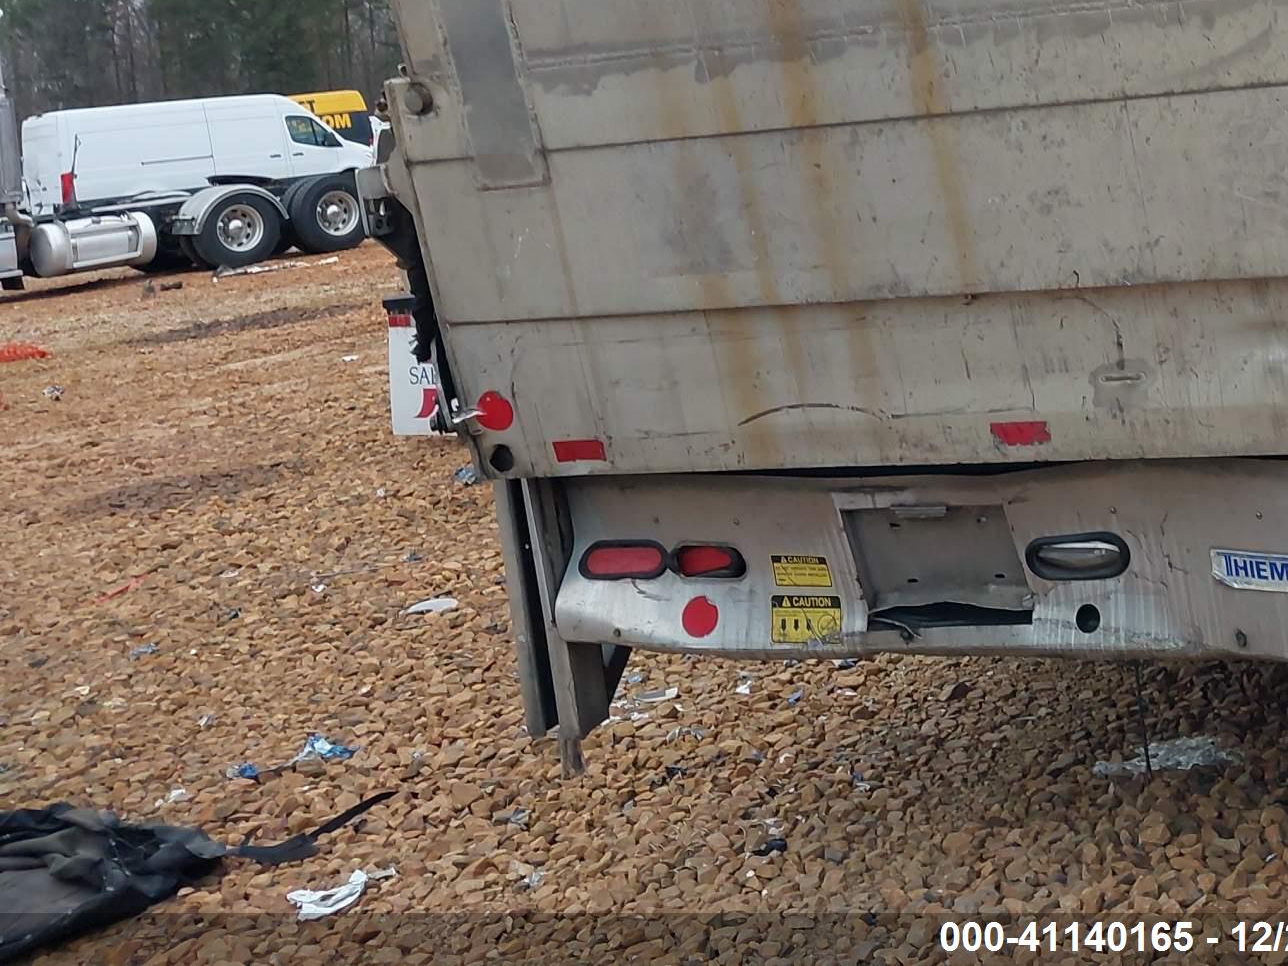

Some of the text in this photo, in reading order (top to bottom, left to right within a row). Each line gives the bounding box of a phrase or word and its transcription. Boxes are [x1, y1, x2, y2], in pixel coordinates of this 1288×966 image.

[322, 113, 352, 129] OM
[788, 556, 819, 564] CAUTION
[792, 596, 832, 607] CAUTION
